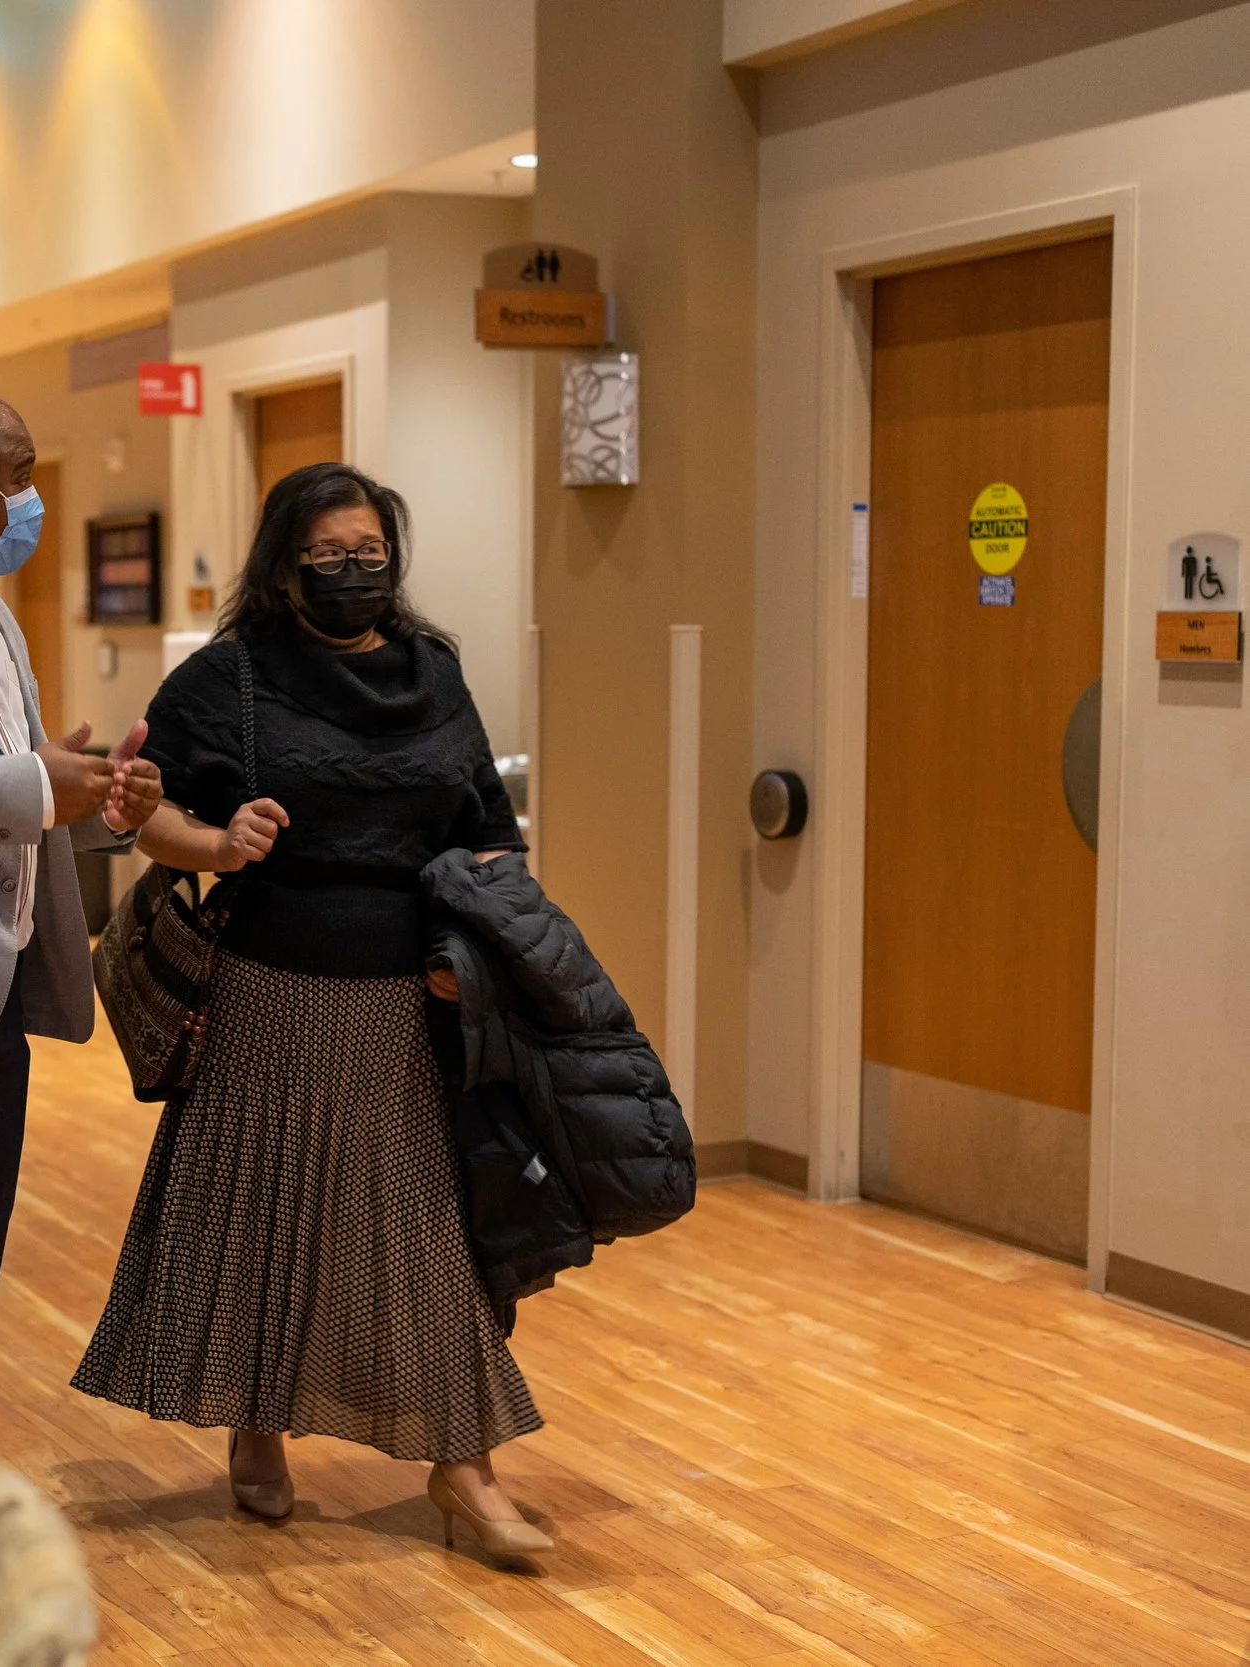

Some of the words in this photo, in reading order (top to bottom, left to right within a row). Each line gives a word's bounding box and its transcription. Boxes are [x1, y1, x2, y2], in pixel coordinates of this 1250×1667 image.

[499, 306, 586, 328] Restrooms
[976, 505, 1022, 516] AUTOMATIC
[972, 521, 1026, 537] CAUTION
[986, 543, 1009, 553] DOOR
